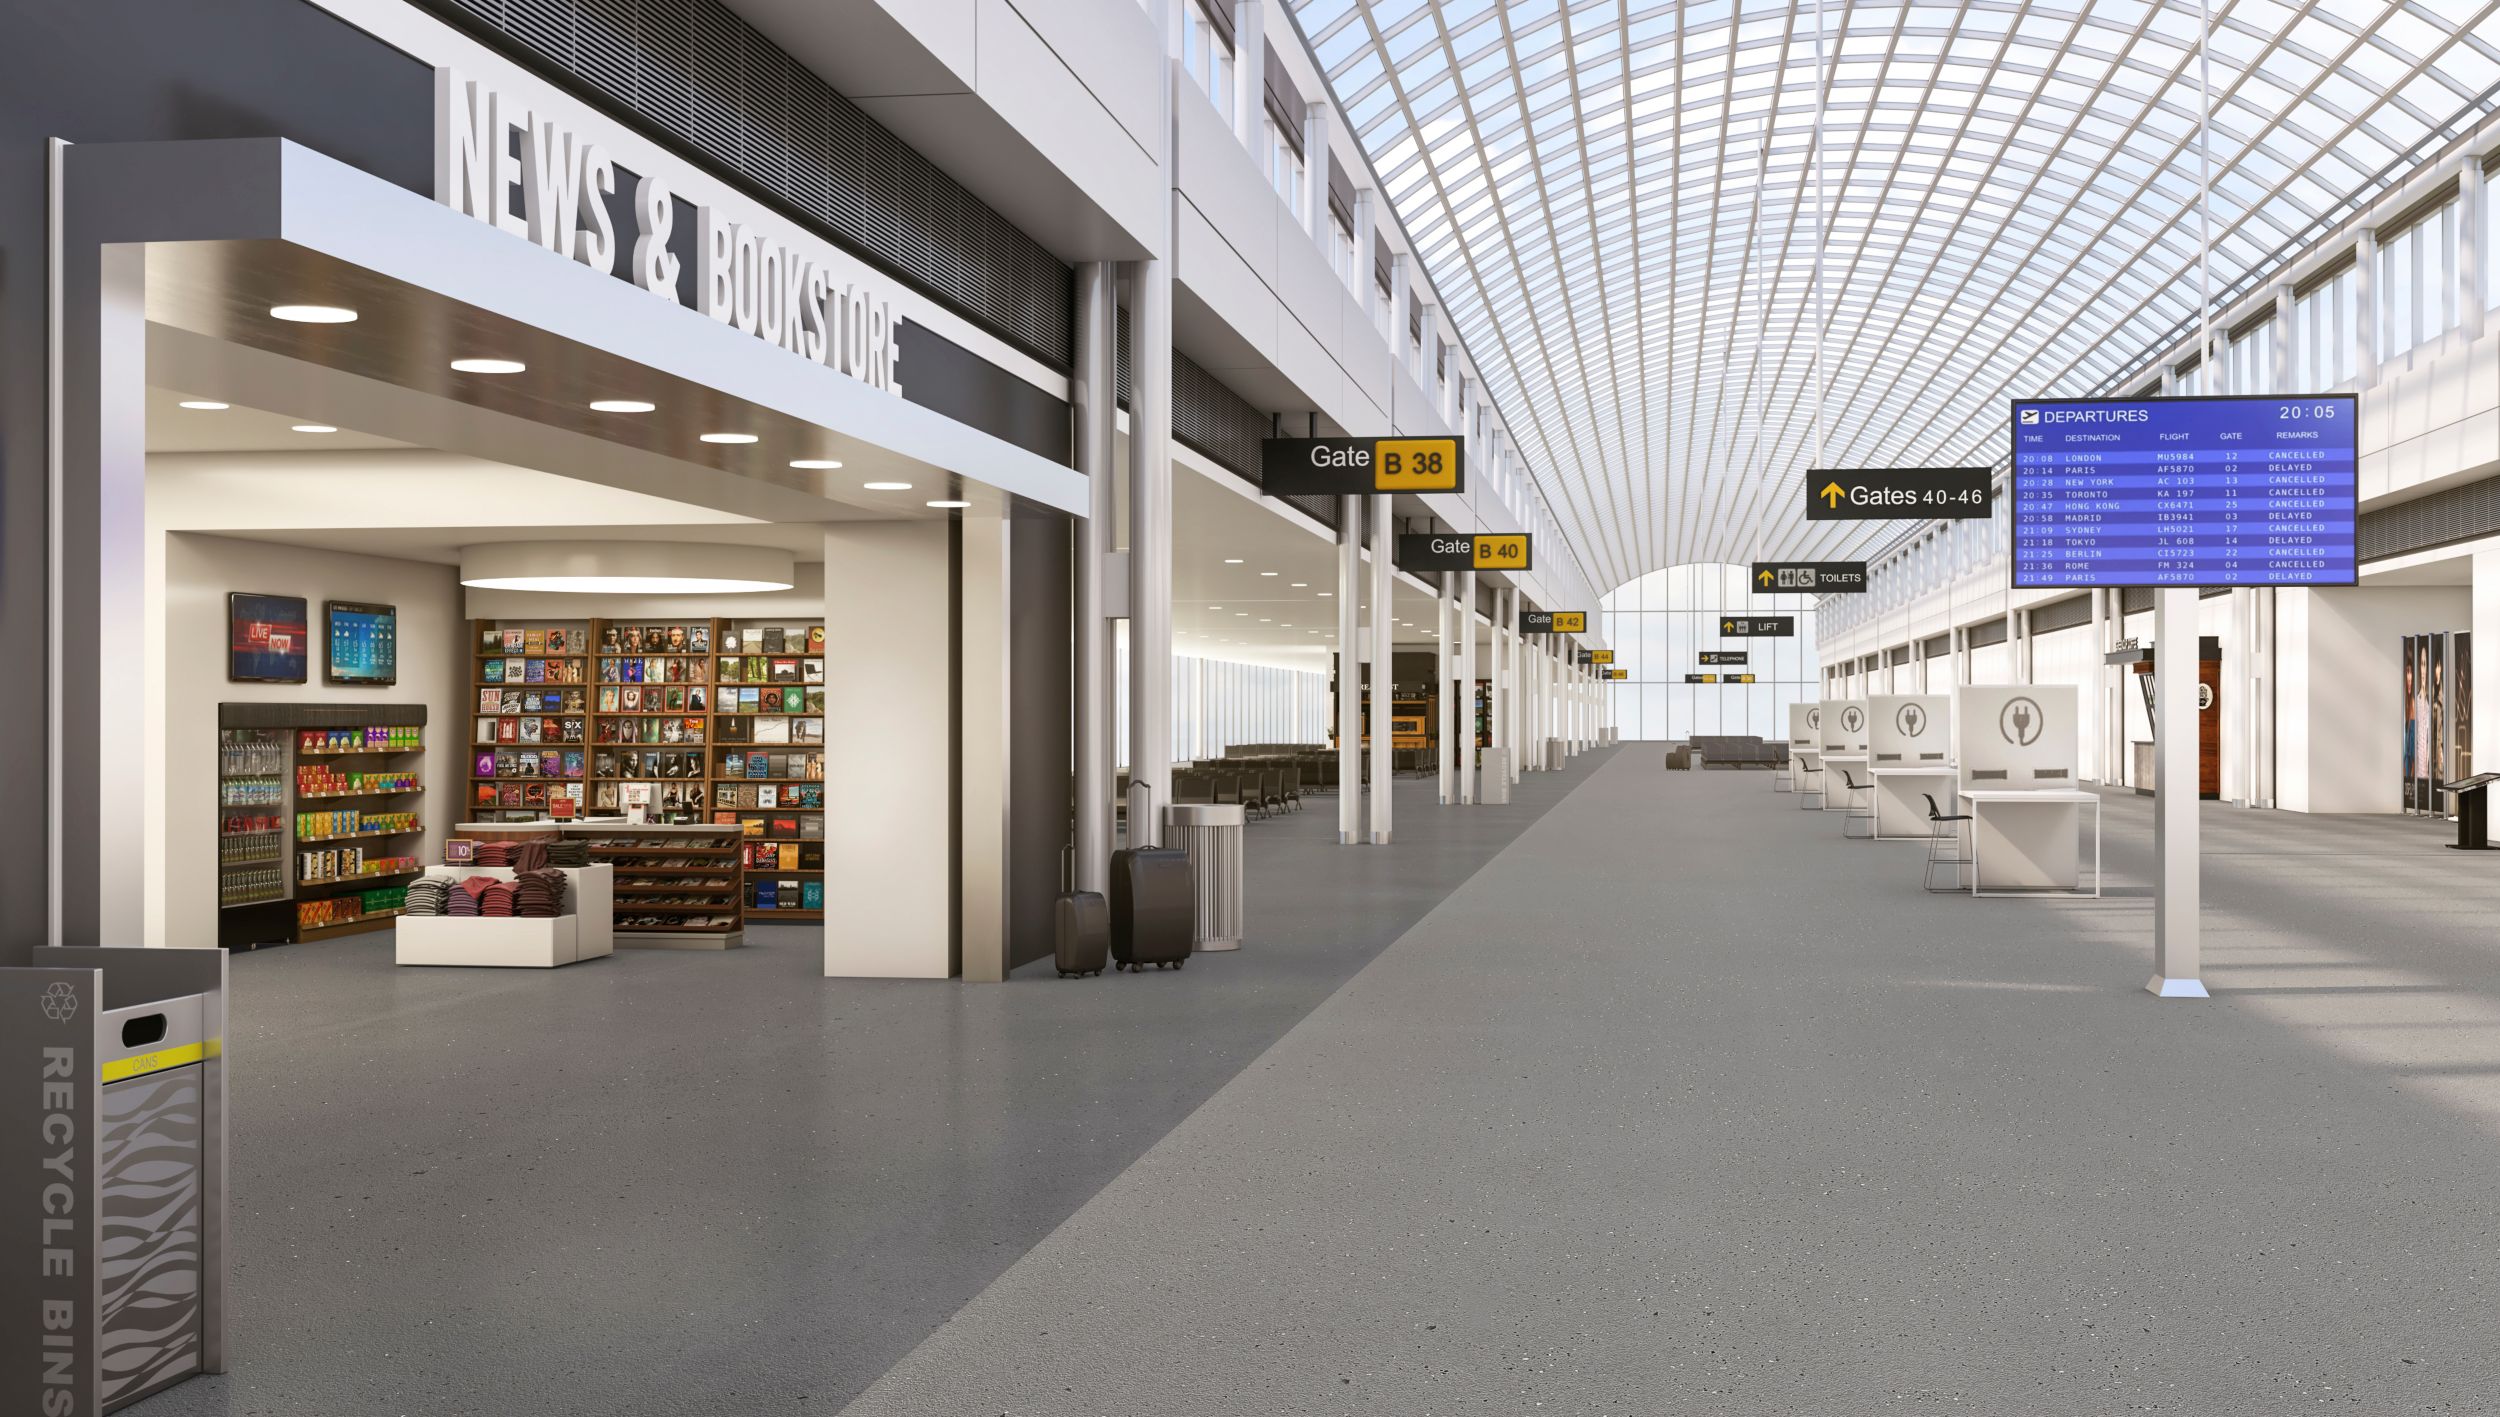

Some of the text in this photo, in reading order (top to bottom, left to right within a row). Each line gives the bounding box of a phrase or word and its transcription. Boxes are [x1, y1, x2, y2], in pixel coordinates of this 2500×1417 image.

[436, 67, 902, 398] NEWS & BOOKSTORE
[2044, 405, 2335, 424] DEPARTURES 20:05
[2023, 430, 2319, 443] TIME DESTINATION FLIGHT GATE REMARKS
[1310, 445, 1443, 475] Gate B 38
[2023, 450, 2325, 463] 20:08 LONDON MU5984 12 CANCELLED
[2023, 463, 2313, 475] 20:14 PARIS AF5870 02 DELAYED
[2023, 475, 2325, 487] 20:28 NEW YORK AC 103 13 CANCELLED
[1850, 485, 1983, 507] Gates 40-46
[2023, 491, 2053, 500] 20:35
[2066, 490, 2108, 499] TORONTO
[2177, 489, 2194, 498] 197
[2226, 489, 2237, 497] 11
[2268, 487, 2325, 497] CANCELLED
[2023, 499, 2325, 511] 20:47 HONG KONG CX6471 25 CANCELLED
[2023, 511, 2313, 523] 20:58 MADRID IB3941 03 DELAYED
[2023, 523, 2325, 535] 21:09 SYDNEY LH5021 17 CANCELLED
[2023, 536, 2313, 547] 21:18 TOKYO JL 608 14 DELAYED
[1430, 539, 1519, 559] Gate B 40
[2023, 547, 2325, 559] 21:25 BERLIN CI5723 22 CANCELLED
[2023, 560, 2325, 571] 21:36 ROME FM 324 04 CANCELLED
[1820, 572, 1861, 583] TOILETS
[2023, 572, 2313, 582] 21:49 PARIS AF5870 02 DELAYED
[1528, 613, 1579, 628] Gate B 42
[1758, 621, 1778, 632] LIFT
[251, 627, 268, 639] LIVE
[271, 637, 289, 649] NOW
[482, 690, 501, 702] SUN
[132, 1055, 159, 1072] CANS
[42, 1046, 75, 1417] RECYCLE BINS
